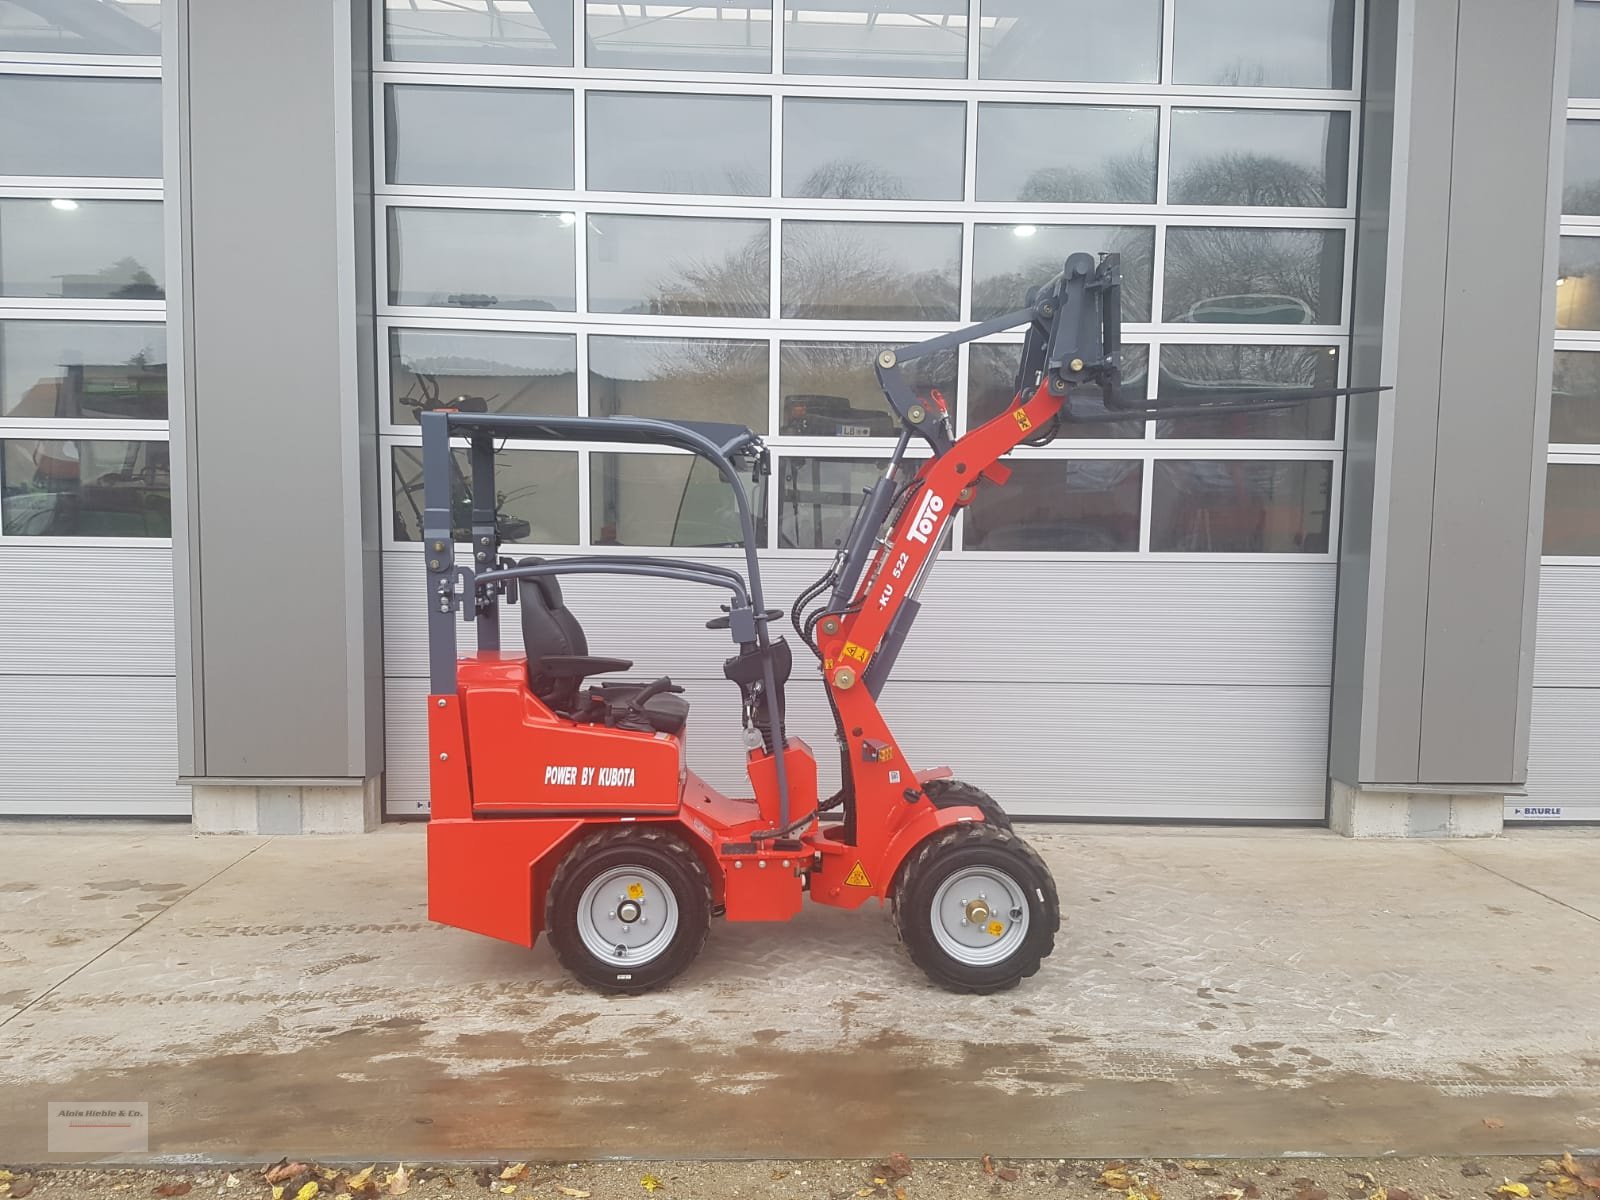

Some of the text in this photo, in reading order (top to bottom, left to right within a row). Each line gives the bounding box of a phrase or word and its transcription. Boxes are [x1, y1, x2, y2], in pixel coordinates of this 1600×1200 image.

[906, 488, 944, 544] TOYO
[892, 552, 909, 579] 522
[544, 766, 635, 787] POWER BY KUBOTA
